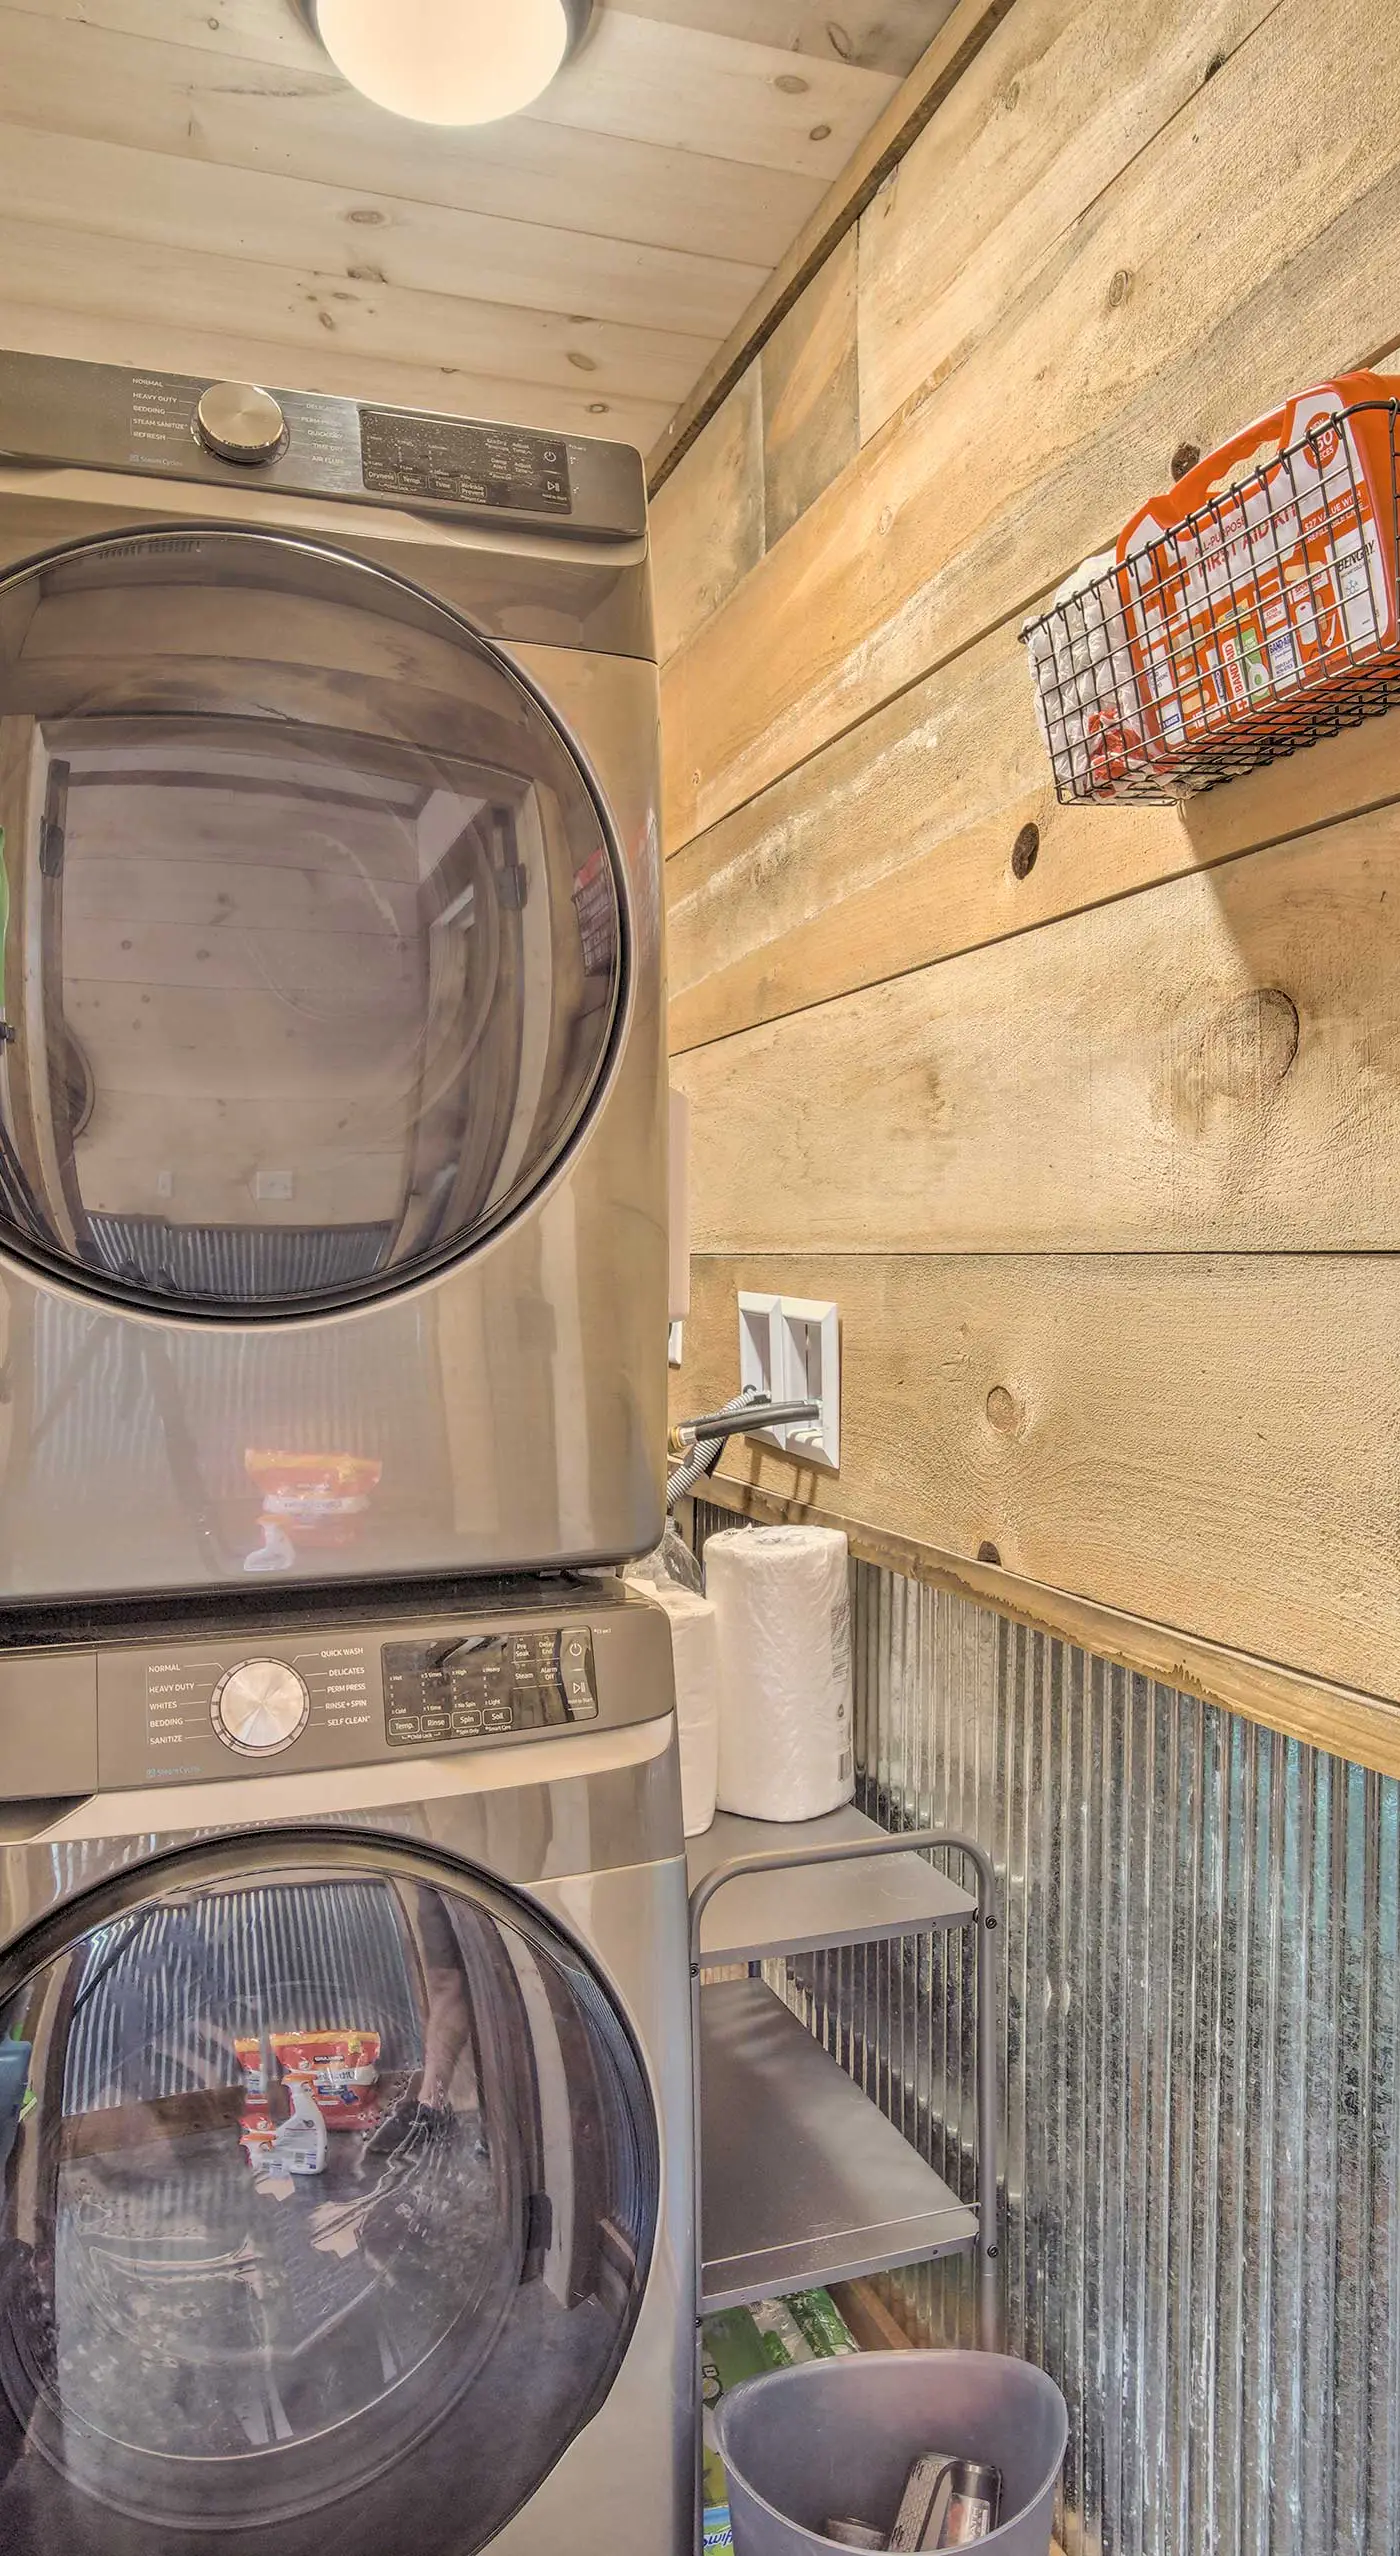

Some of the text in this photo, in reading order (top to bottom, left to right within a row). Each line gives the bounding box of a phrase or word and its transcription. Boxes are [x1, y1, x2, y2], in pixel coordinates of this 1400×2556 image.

[132, 378, 164, 387] NORMAL
[133, 392, 157, 401] HEAVY
[133, 405, 166, 414] BEDDING
[133, 431, 166, 441] REFRESH
[320, 1647, 364, 1658] QUICK WASH
[148, 1663, 181, 1673] NORMAL
[328, 1666, 365, 1677] DELICATES
[149, 1682, 195, 1694] HEAVY DUTY
[327, 1682, 366, 1693] PERM PRESS
[149, 1700, 178, 1710] WHITES
[149, 1717, 184, 1728] BEDDING
[327, 1718, 344, 1727] SELF
[427, 1719, 446, 1727] Rinse
[459, 1715, 475, 1725] Spin
[149, 1734, 183, 1745] SANITIZE
